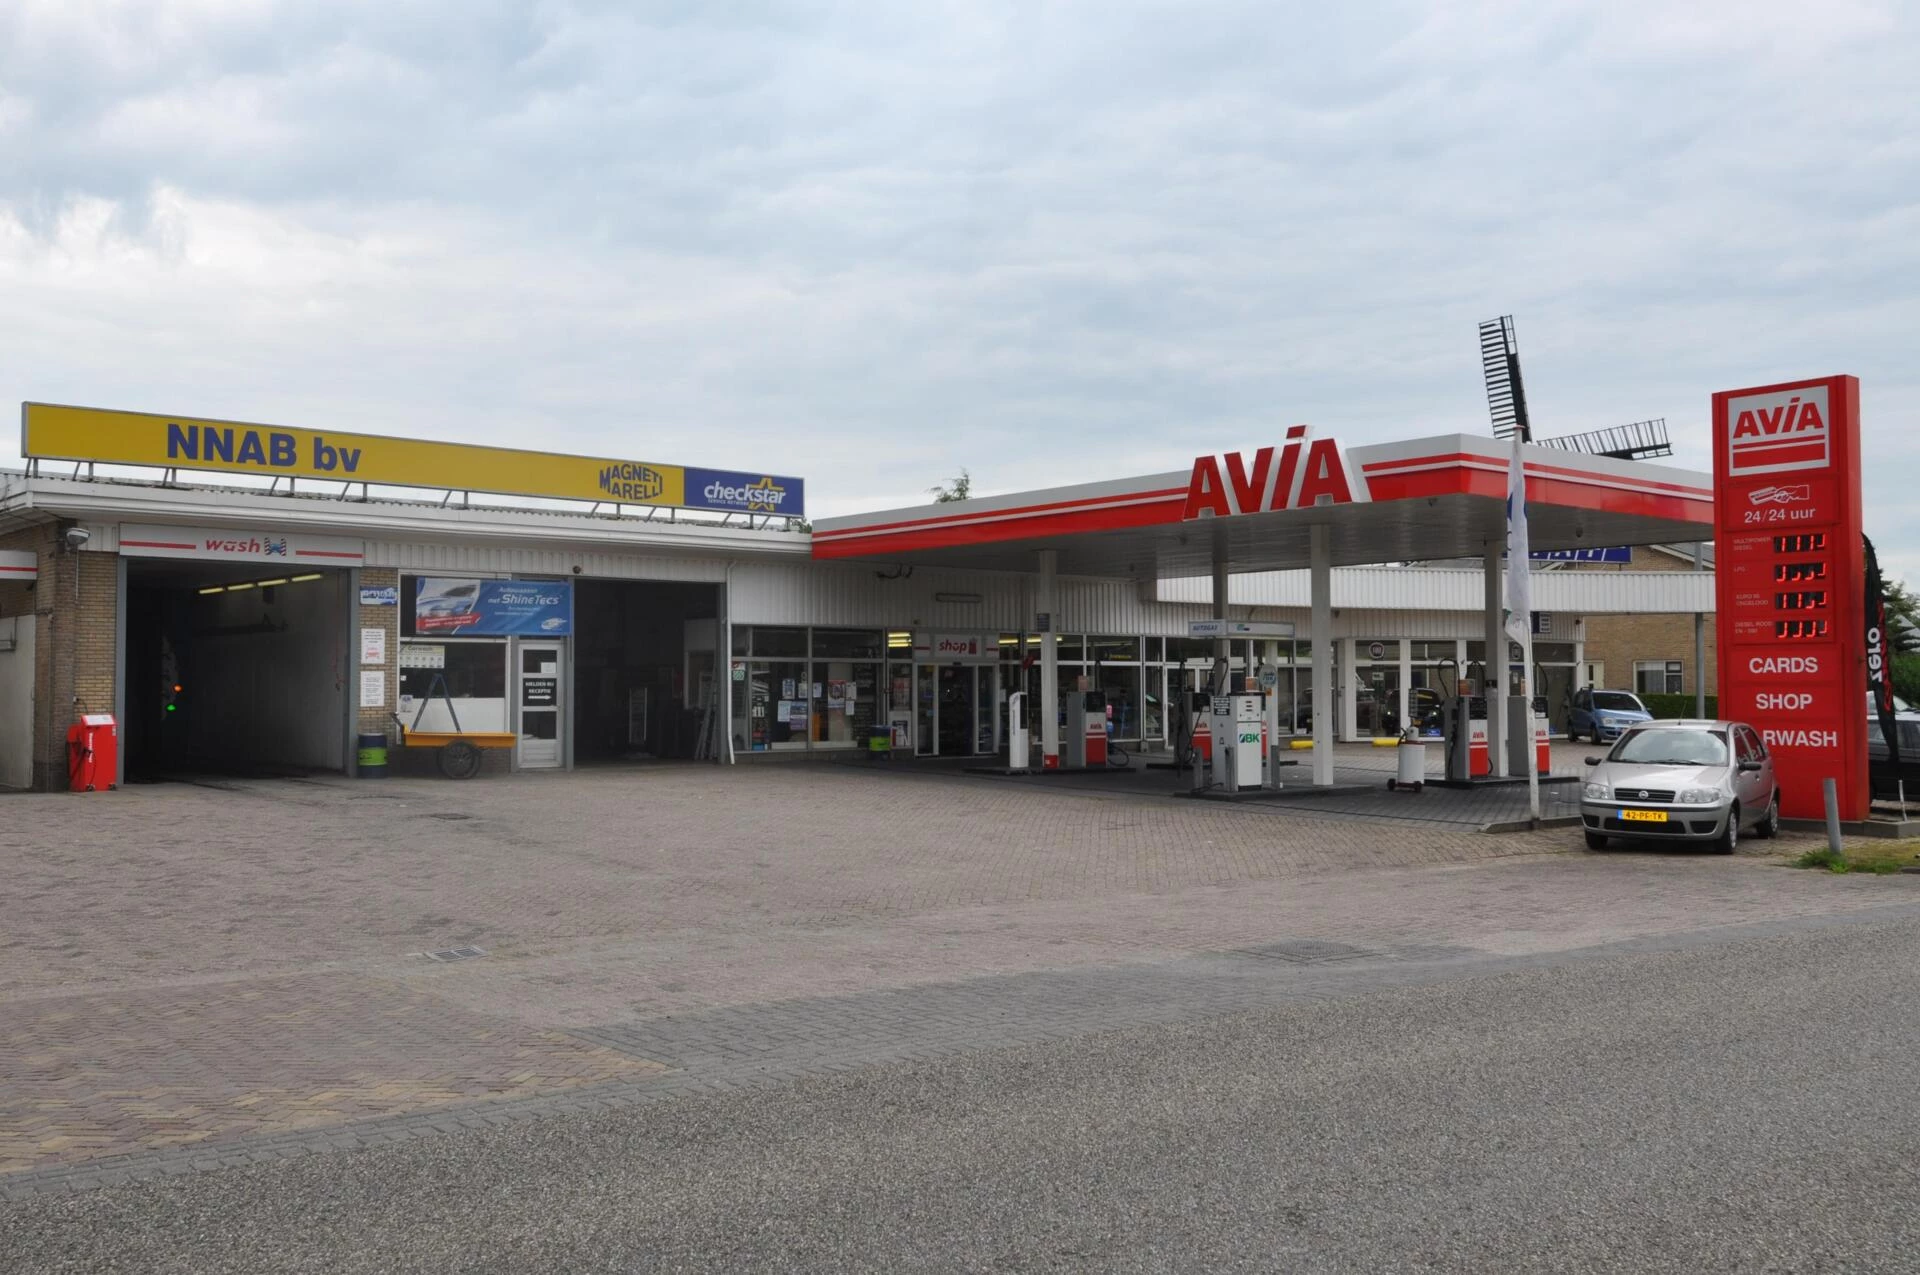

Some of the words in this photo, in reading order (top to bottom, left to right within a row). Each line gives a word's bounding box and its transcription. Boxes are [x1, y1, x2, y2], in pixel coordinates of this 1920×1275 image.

[1733, 396, 1824, 439] AVIA
[167, 423, 297, 467] NNAB
[313, 437, 361, 473] bv
[600, 463, 663, 490] MAGNETI
[1183, 424, 1353, 521] AVIA
[704, 481, 786, 504] checkstar
[1744, 508, 1786, 524] 24/24
[1790, 508, 1816, 521] uur
[206, 537, 260, 553] wash
[501, 593, 560, 605] ShineTecs
[939, 639, 967, 654] shop
[1749, 657, 1818, 673] CARDS
[1756, 693, 1813, 710] SHOP
[1763, 729, 1838, 747] RWASH
